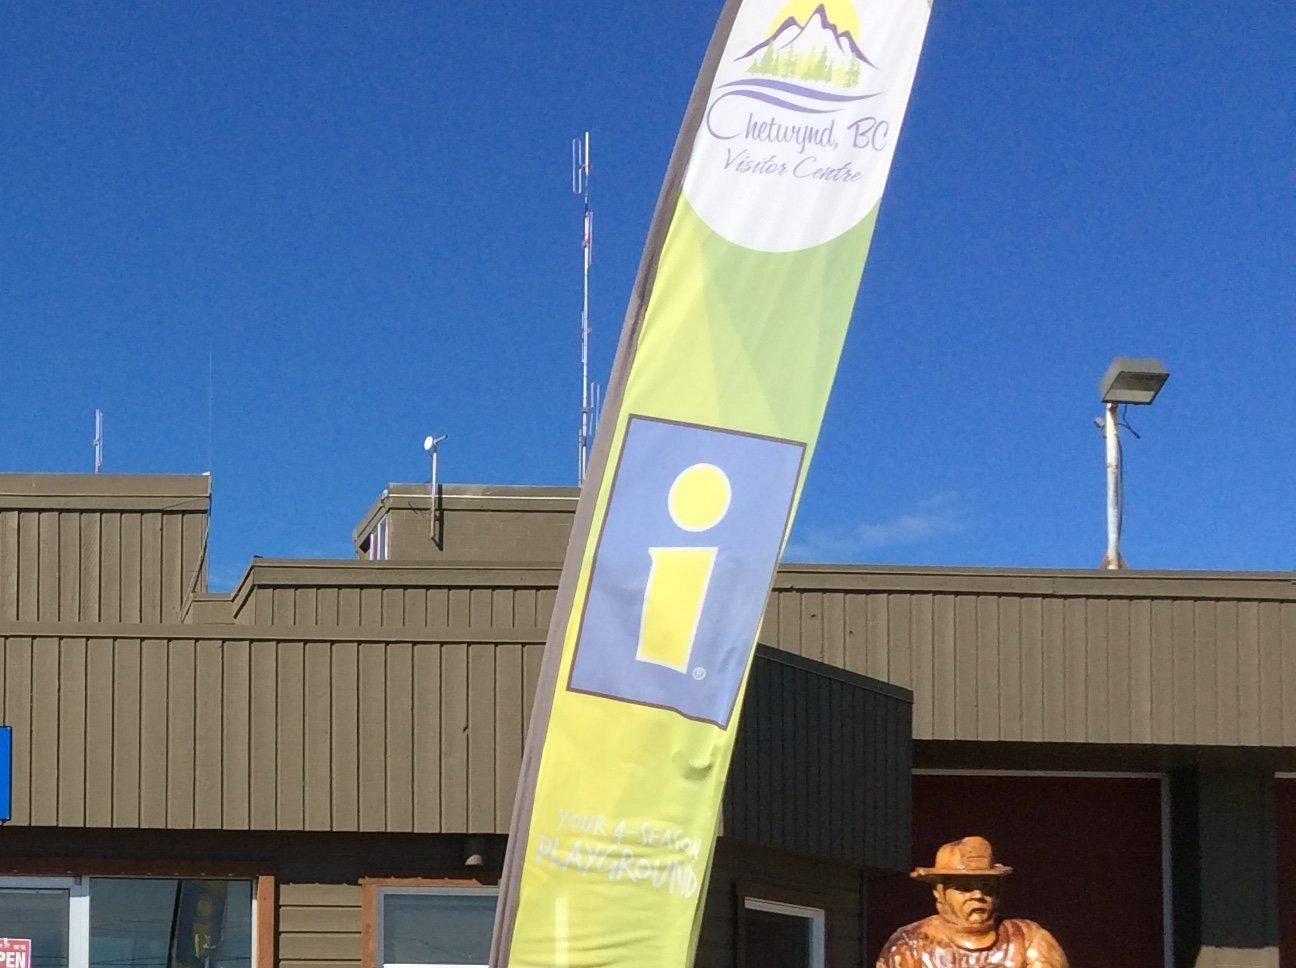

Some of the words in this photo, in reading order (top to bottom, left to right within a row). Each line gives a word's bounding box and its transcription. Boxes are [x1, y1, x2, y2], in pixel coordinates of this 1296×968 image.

[707, 93, 839, 154] Chetwynd,
[847, 116, 890, 151] BC
[724, 148, 787, 177] Visitor
[792, 156, 863, 182] Centre
[558, 808, 606, 836] YOUR
[534, 834, 699, 898] PLAYGROUND
